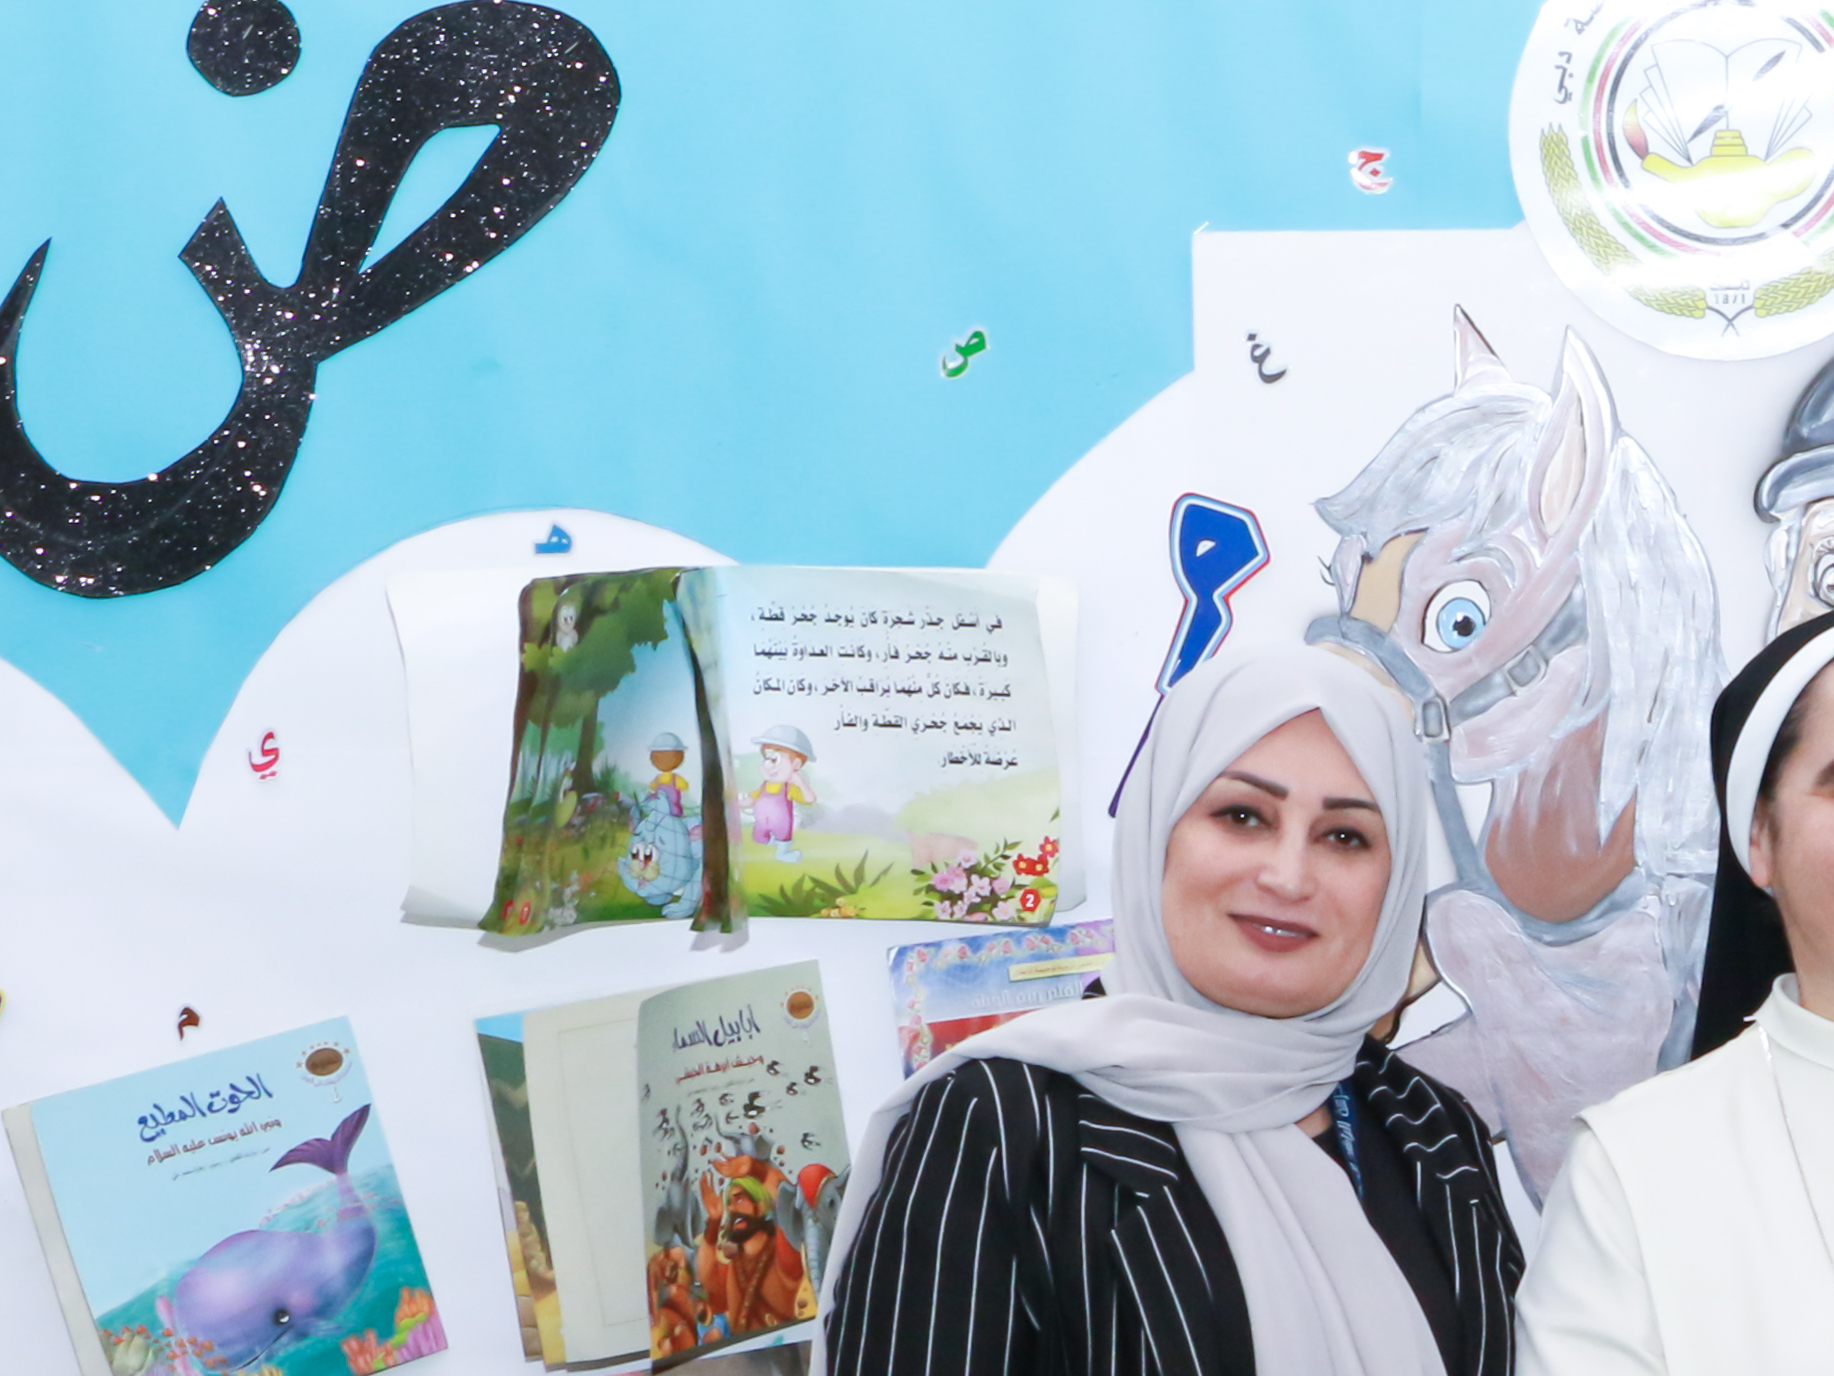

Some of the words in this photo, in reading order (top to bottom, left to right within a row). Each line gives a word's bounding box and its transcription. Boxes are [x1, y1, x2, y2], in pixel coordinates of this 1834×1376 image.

[0, 0, 622, 600] ض
[941, 329, 987, 378] ص
[247, 728, 282, 781] ي
[1025, 893, 1035, 908] 2
[207, 1072, 274, 1114] الحوت
[137, 1091, 207, 1143] المطيع
[238, 1120, 259, 1137] الله
[147, 1144, 181, 1166] السلام
[181, 1135, 206, 1155] عليه
